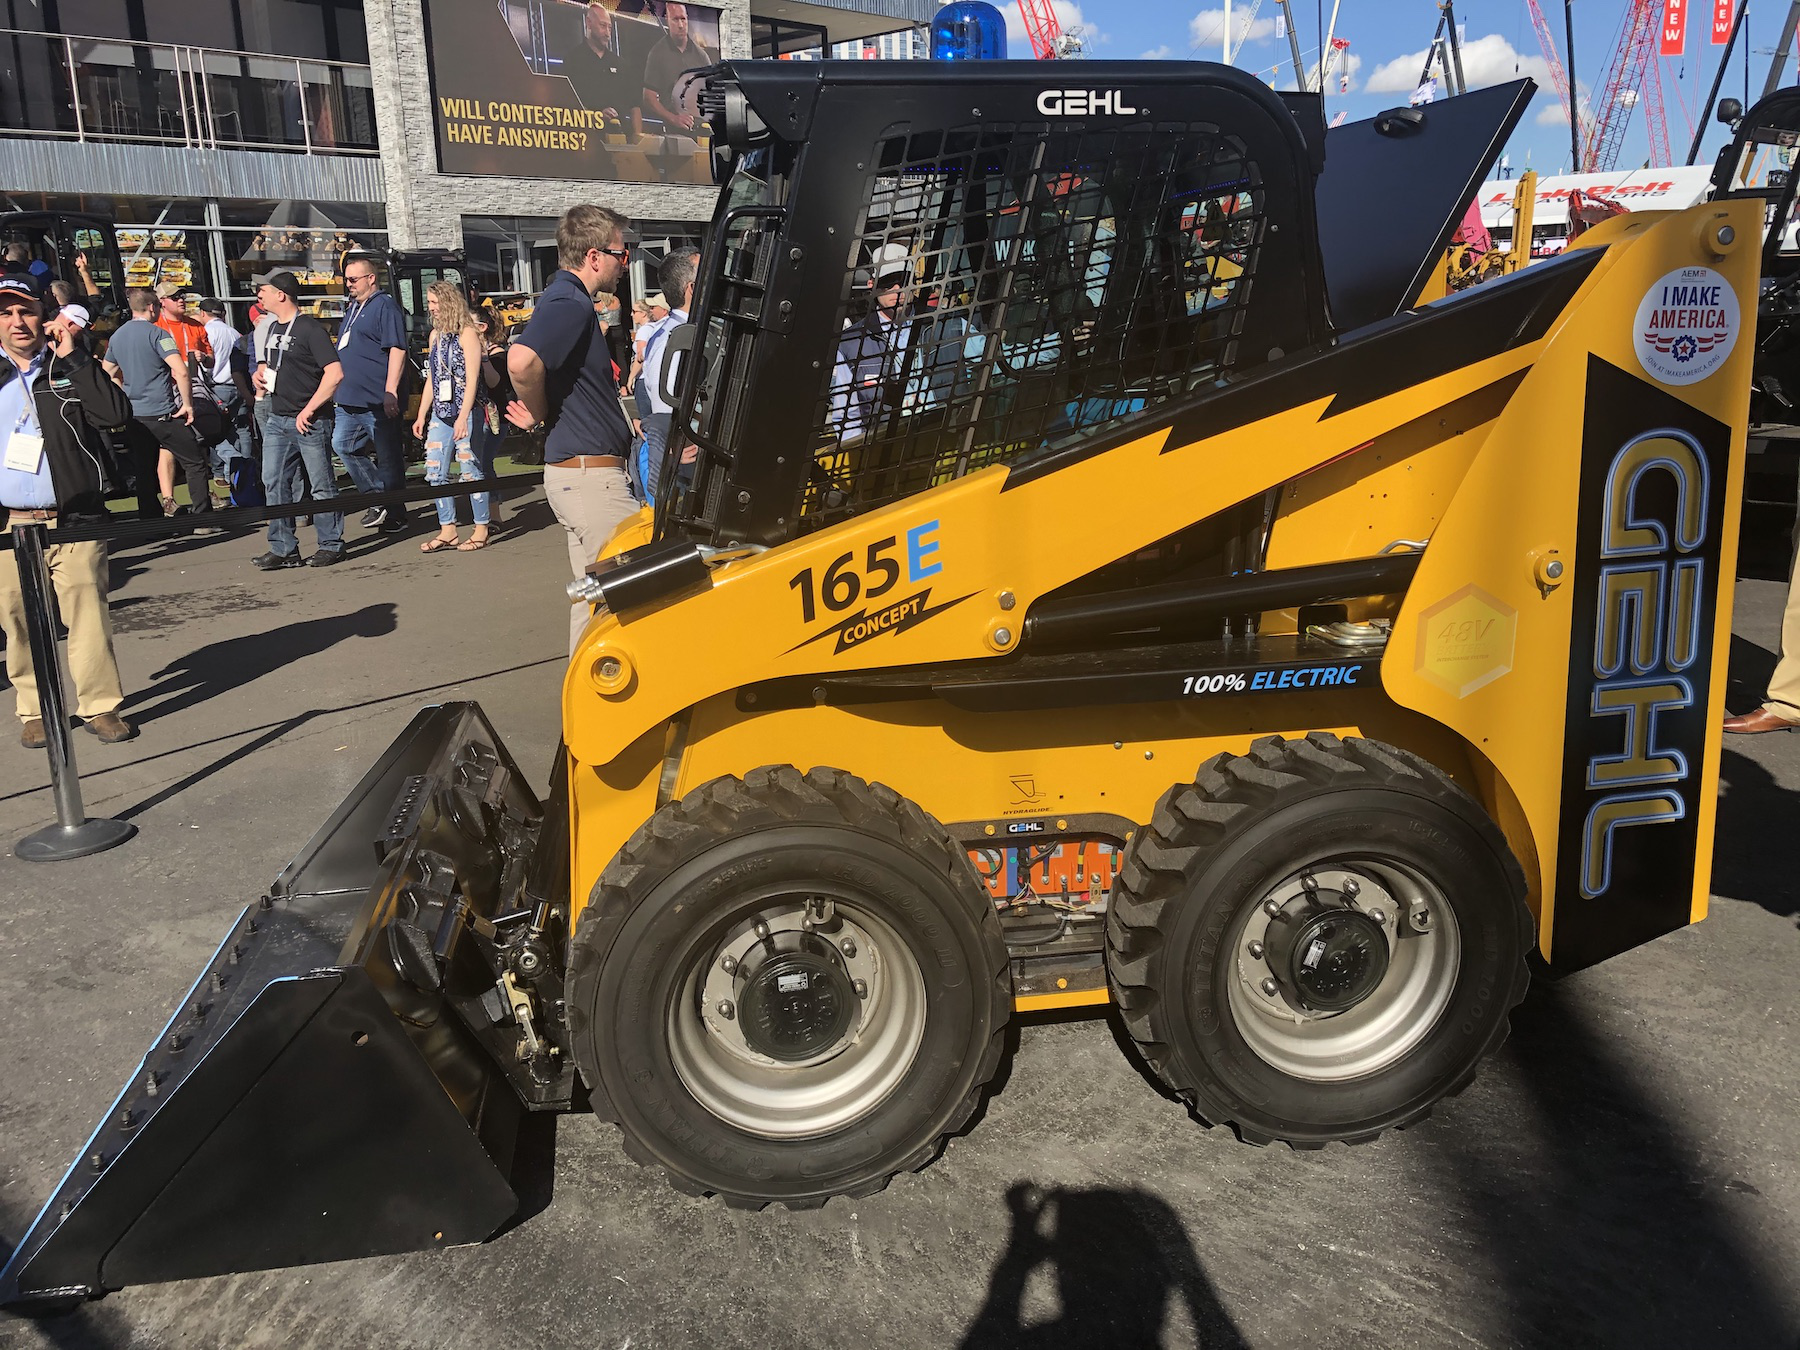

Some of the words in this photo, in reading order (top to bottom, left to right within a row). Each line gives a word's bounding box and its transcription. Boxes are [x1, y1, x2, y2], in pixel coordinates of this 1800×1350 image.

[439, 97, 485, 121] WILL
[488, 101, 605, 130] CONTESTANTS
[1036, 89, 1137, 116] GEHL
[446, 122, 494, 145] HAVE
[497, 126, 587, 151] ANSWERS?
[1681, 270, 1699, 278] AEM
[1662, 286, 1668, 307] I
[1671, 286, 1721, 306] MAKE
[1648, 309, 1726, 329] AMERICA
[1645, 355, 1657, 369] JOIN
[1664, 354, 1721, 378] IMAKEAMERICA.ORG
[788, 518, 943, 624] 165E
[843, 598, 920, 644] CONCEPT
[1437, 619, 1496, 643] 48V
[1579, 426, 1712, 899] GEHL
[1182, 673, 1246, 695] 100%
[1249, 665, 1362, 691] ELECTRIC
[1008, 822, 1043, 833] GEHL
